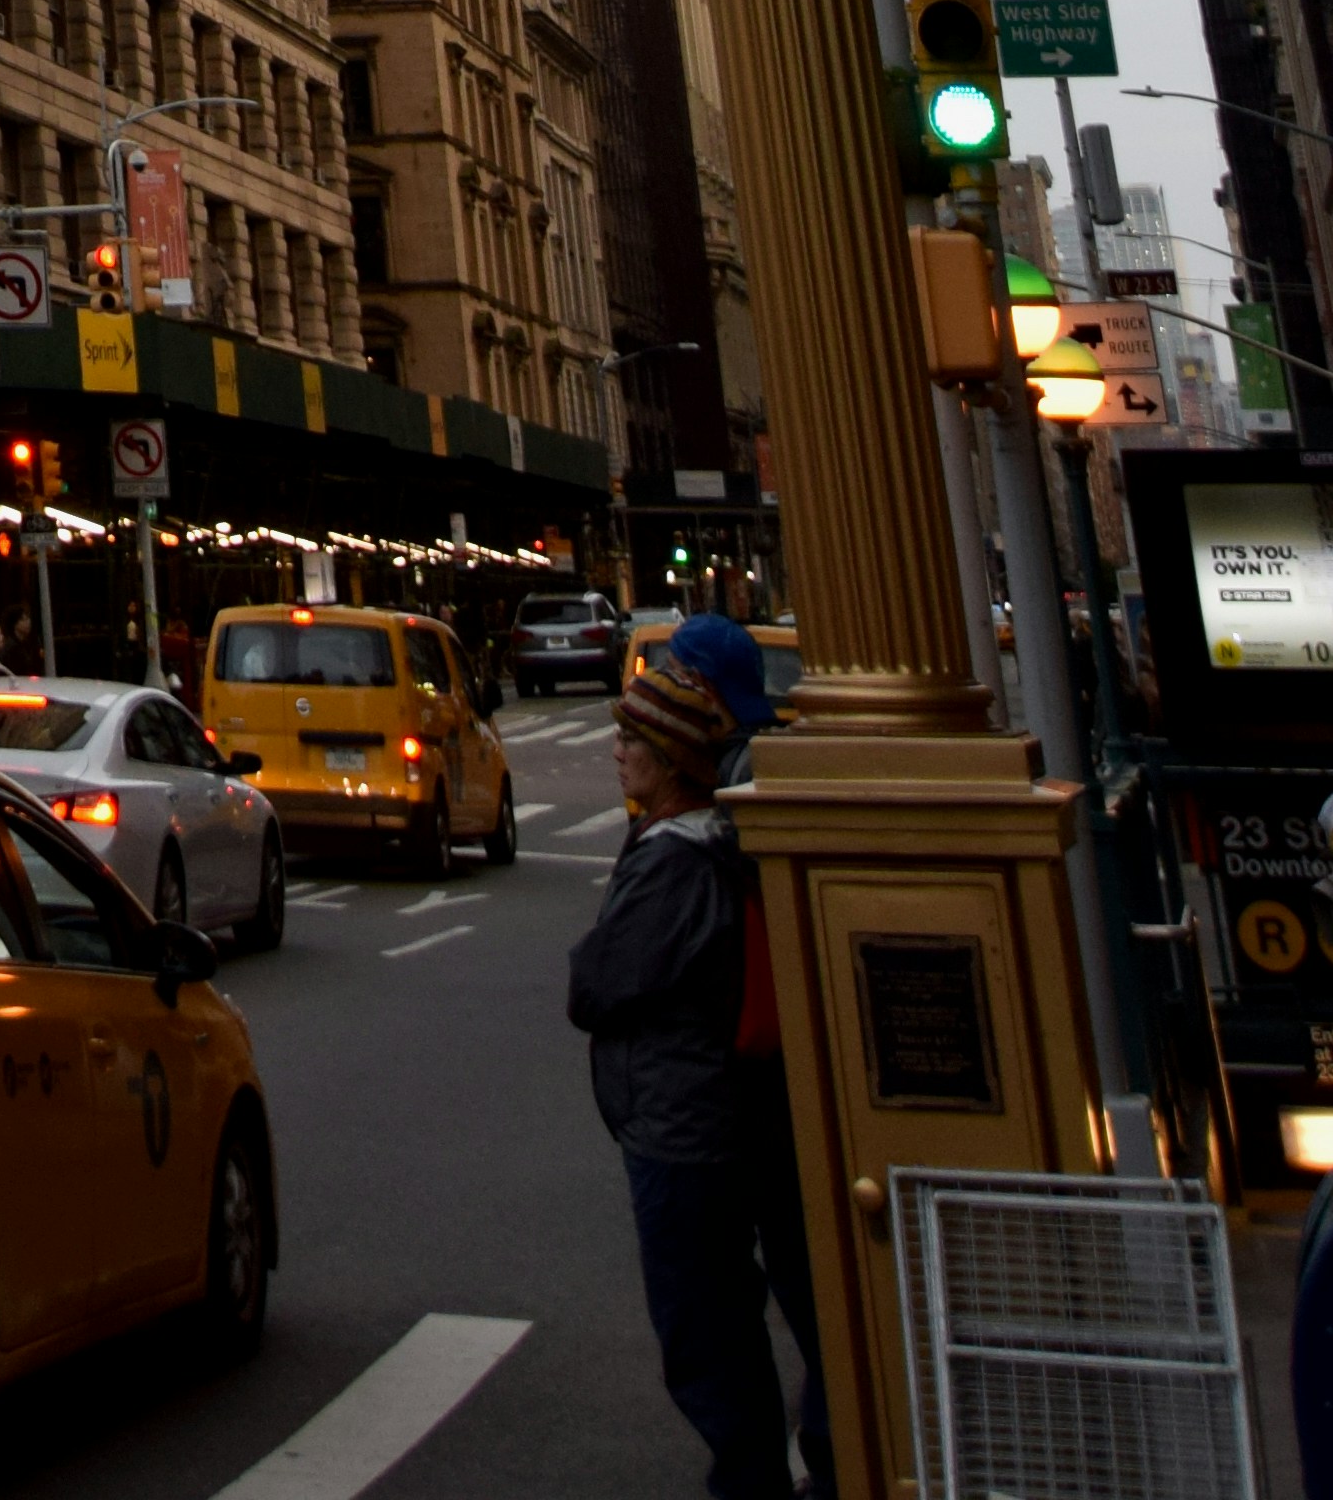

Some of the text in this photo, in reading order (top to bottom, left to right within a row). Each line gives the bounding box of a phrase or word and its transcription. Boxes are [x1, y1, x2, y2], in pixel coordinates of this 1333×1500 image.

[1001, 2, 1101, 22] West Side
[1010, 24, 1098, 46] Highway
[1114, 276, 1128, 293] W
[1134, 276, 1151, 293] 23
[1106, 316, 1147, 331] TRUCK
[84, 339, 119, 365] Sprint
[1109, 340, 1151, 355] ROUTE
[1211, 545, 1298, 560] IT'S YOU.
[1214, 562, 1291, 576] OWN IT.
[1220, 644, 1233, 659] N
[1220, 815, 1326, 852] 23 St
[1256, 915, 1289, 955] R
